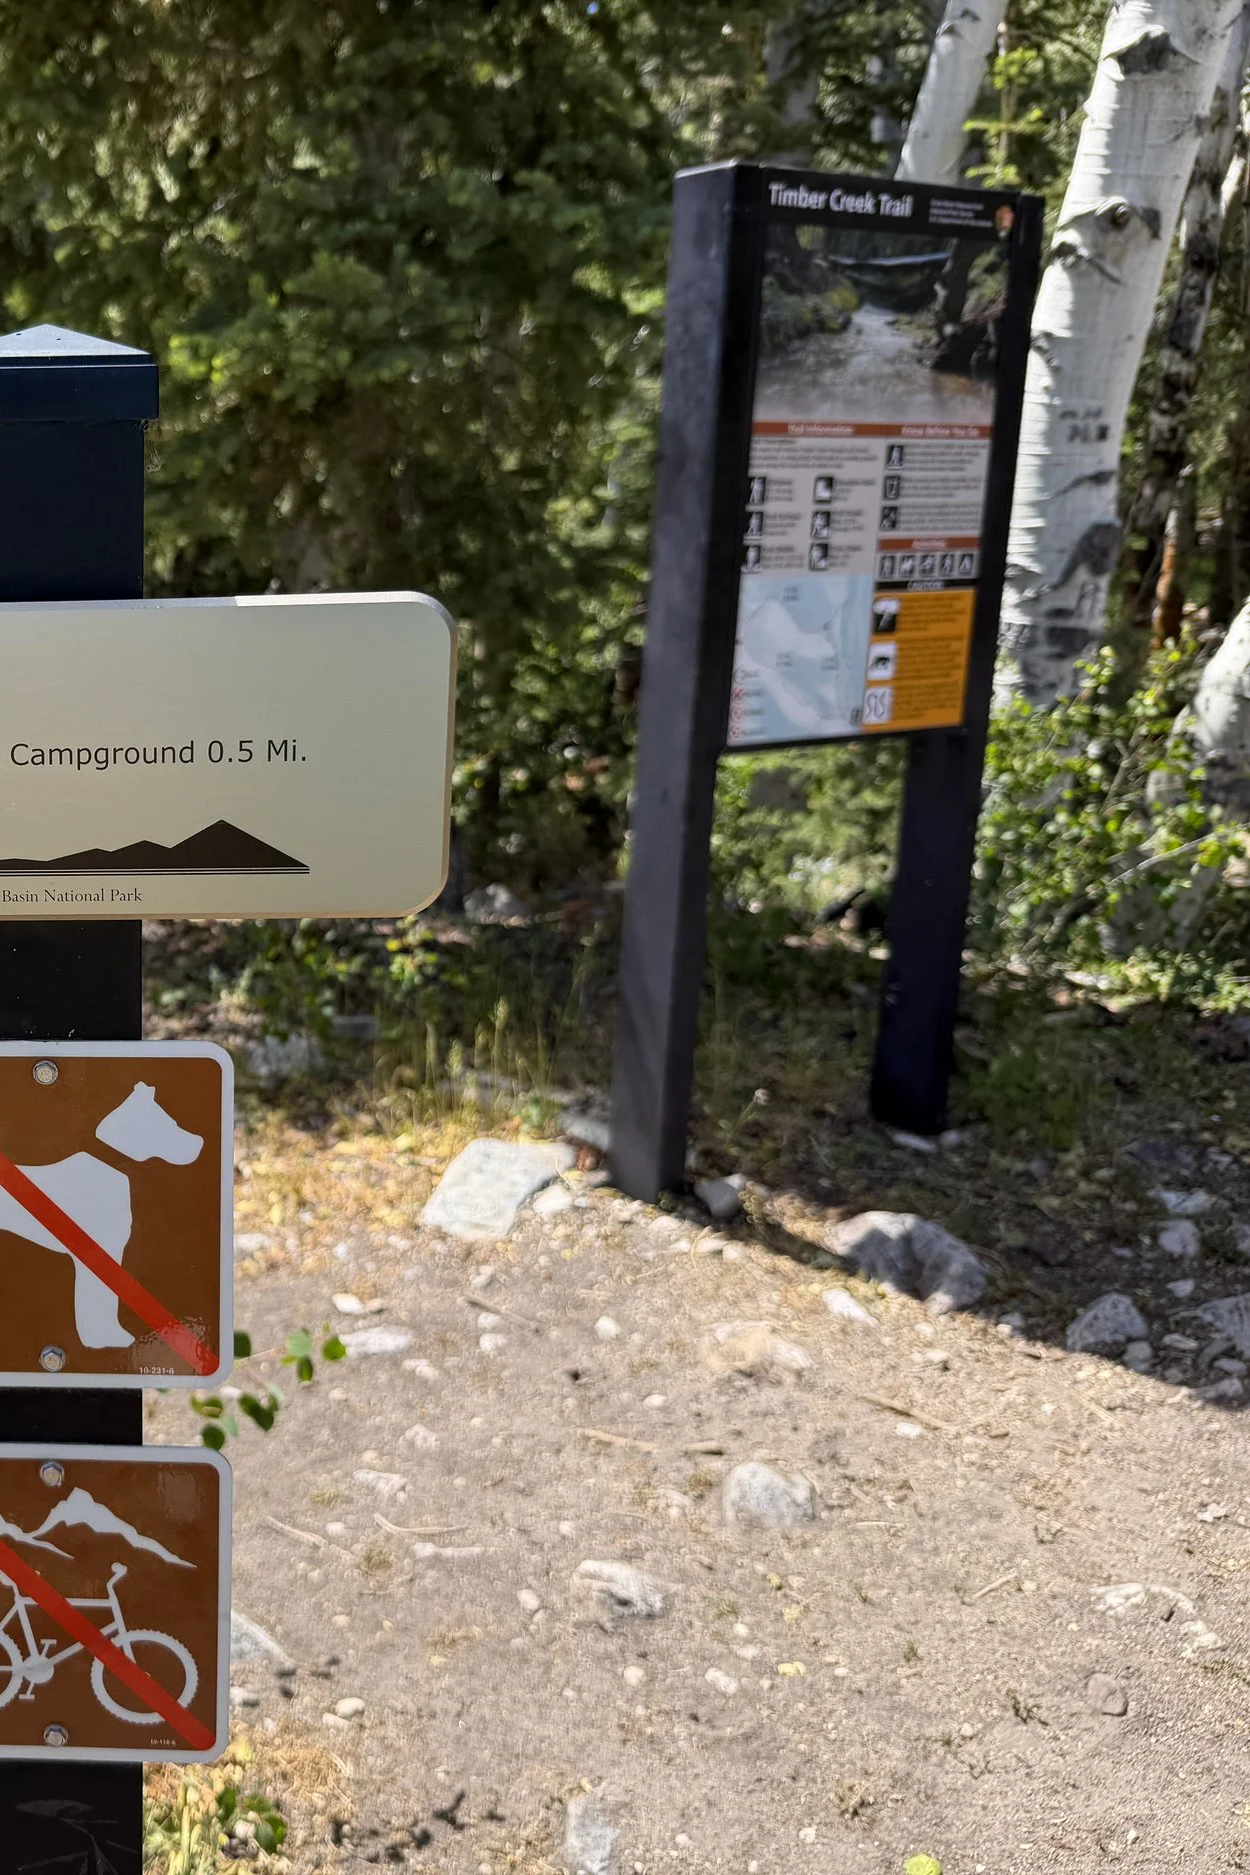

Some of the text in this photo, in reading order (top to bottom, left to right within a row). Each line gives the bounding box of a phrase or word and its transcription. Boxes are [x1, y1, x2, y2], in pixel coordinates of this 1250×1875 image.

[769, 182, 827, 209] Timber
[830, 188, 875, 214] Creek
[878, 193, 914, 217] Trail
[10, 740, 195, 771] Campground
[208, 740, 254, 763] 0.5
[267, 739, 307, 762] Mi.
[2, 889, 39, 903] Basin
[44, 888, 105, 902] National
[110, 888, 143, 902] Park
